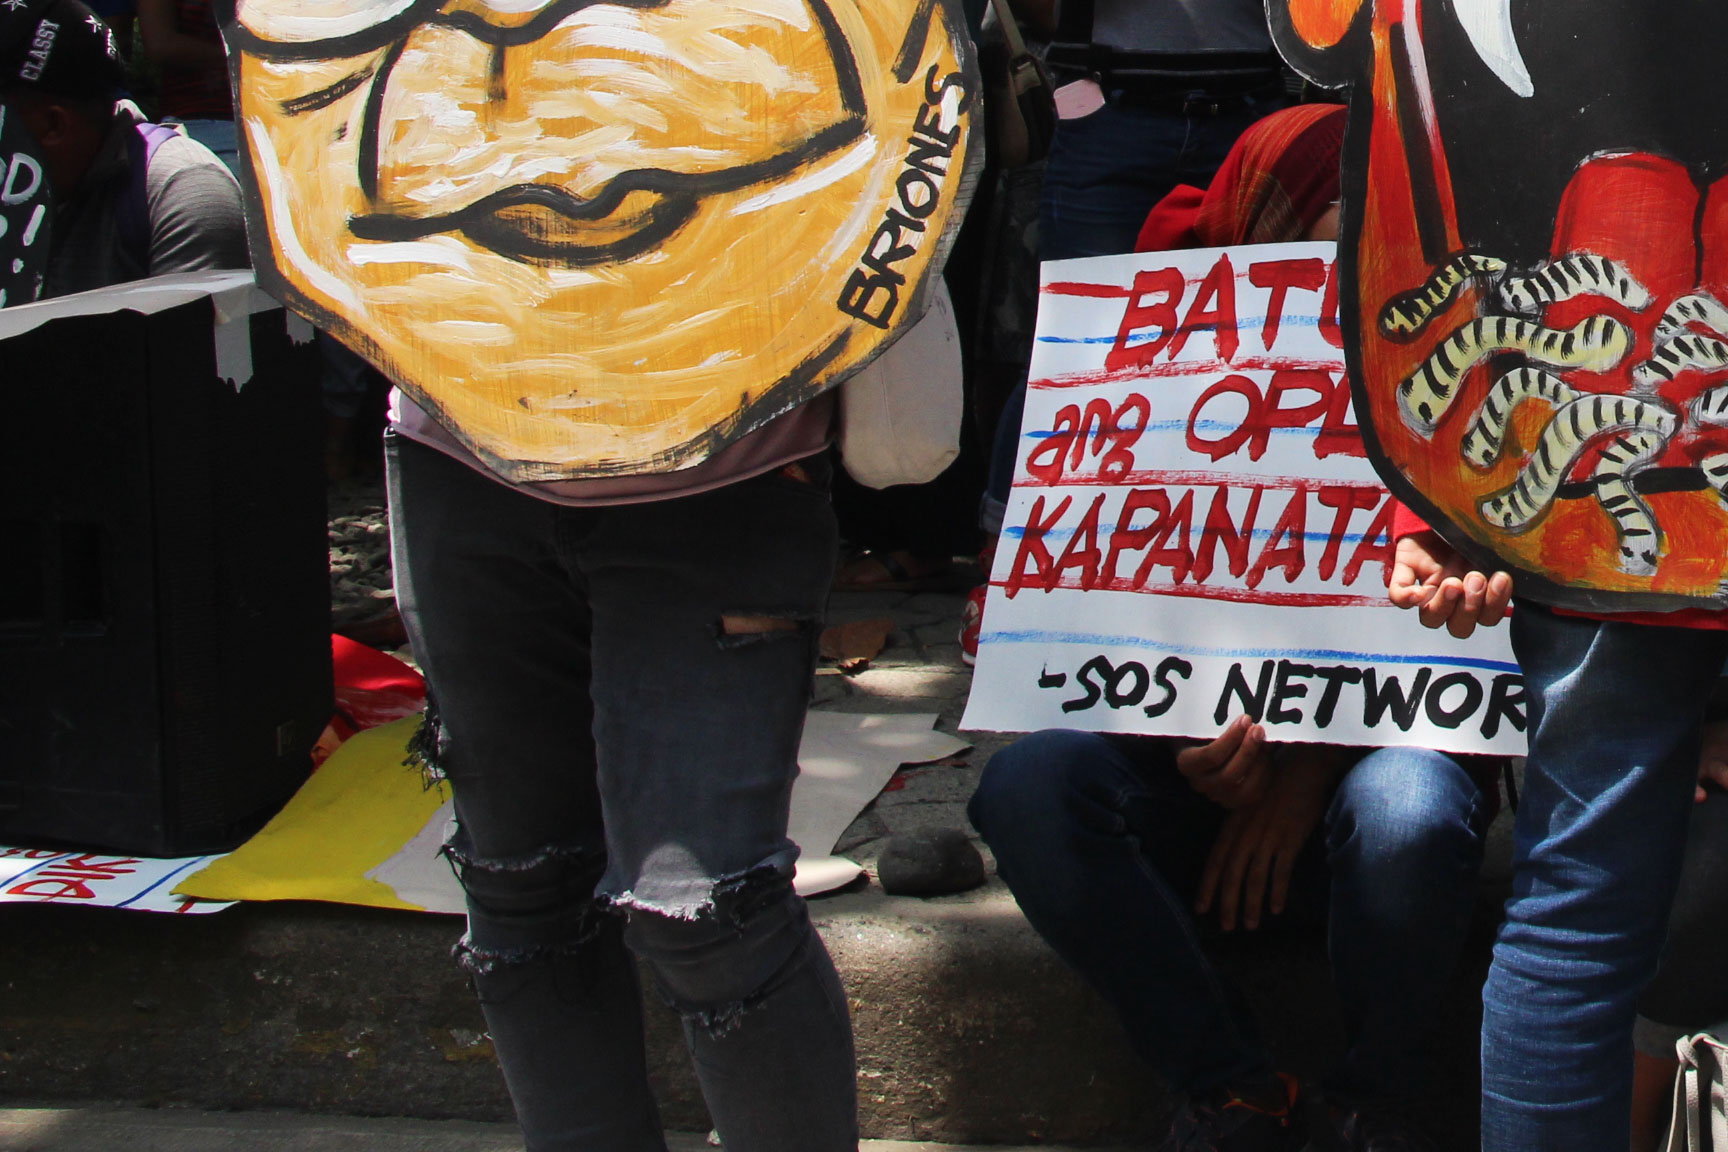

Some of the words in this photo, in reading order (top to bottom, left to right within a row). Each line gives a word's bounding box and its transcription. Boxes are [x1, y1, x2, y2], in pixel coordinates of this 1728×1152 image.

[20, 18, 61, 81] CLASSY
[837, 63, 975, 329] BRIONES
[1025, 393, 1152, 486] ang
[1038, 654, 1192, 717] -SOS
